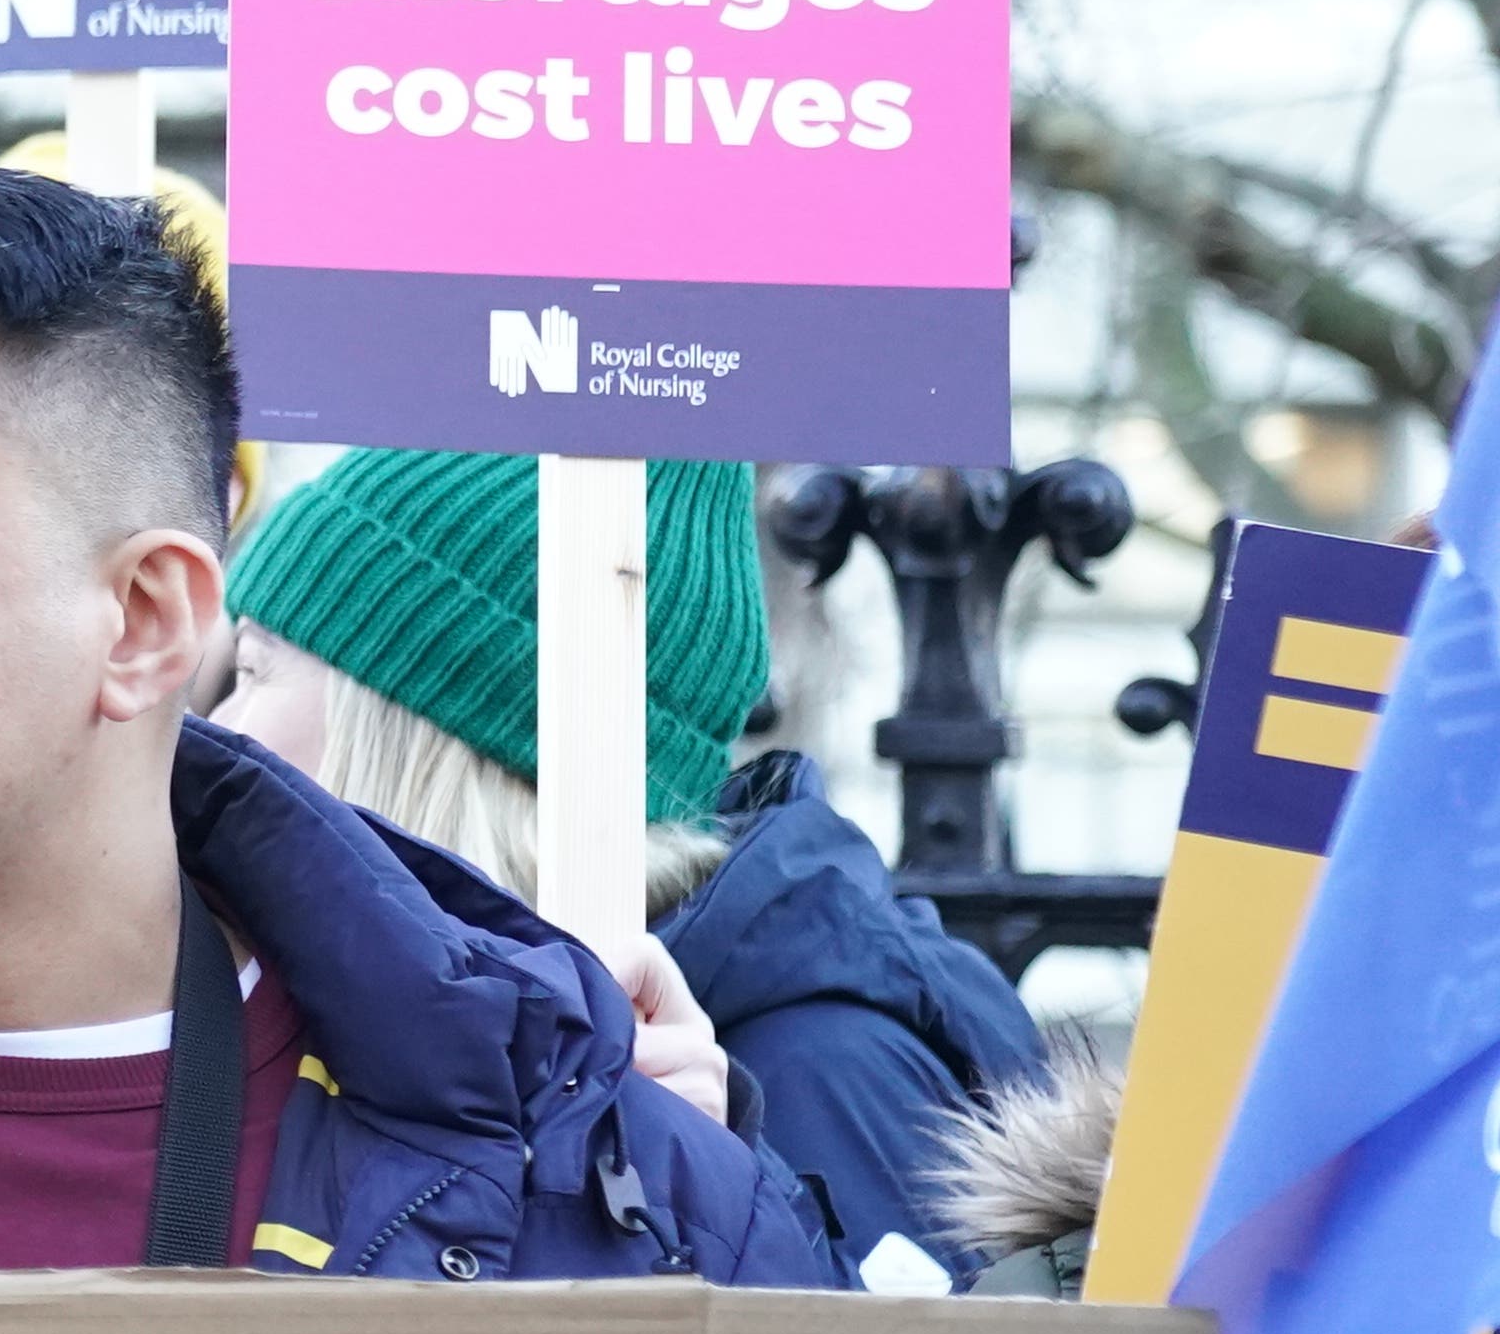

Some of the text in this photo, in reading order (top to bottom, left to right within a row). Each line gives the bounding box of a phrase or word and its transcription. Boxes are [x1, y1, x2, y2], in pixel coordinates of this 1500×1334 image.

[86, 1, 122, 37] of
[325, 45, 914, 151] cost lives
[590, 339, 741, 377] Royal College
[588, 369, 707, 405] of Nursing
